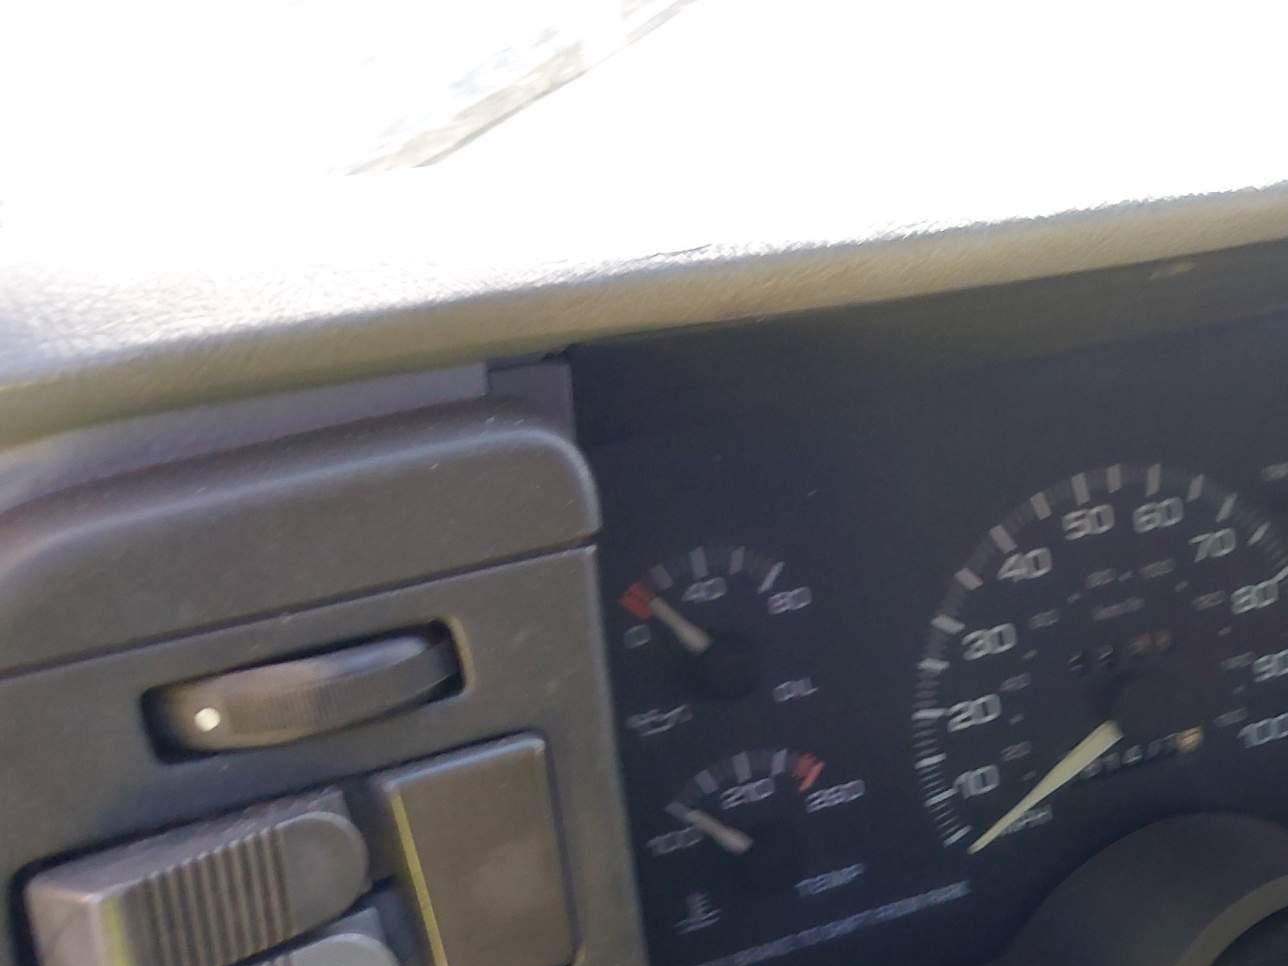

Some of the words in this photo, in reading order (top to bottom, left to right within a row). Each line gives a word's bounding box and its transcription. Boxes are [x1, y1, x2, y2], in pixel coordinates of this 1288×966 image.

[1062, 504, 1115, 541] 50
[1133, 498, 1184, 533] 60
[1188, 528, 1237, 563] 70
[998, 548, 1053, 582] 40
[1231, 581, 1281, 616] 80
[961, 623, 1016, 661] 30
[947, 694, 1002, 732] 20
[953, 764, 999, 799] 10
